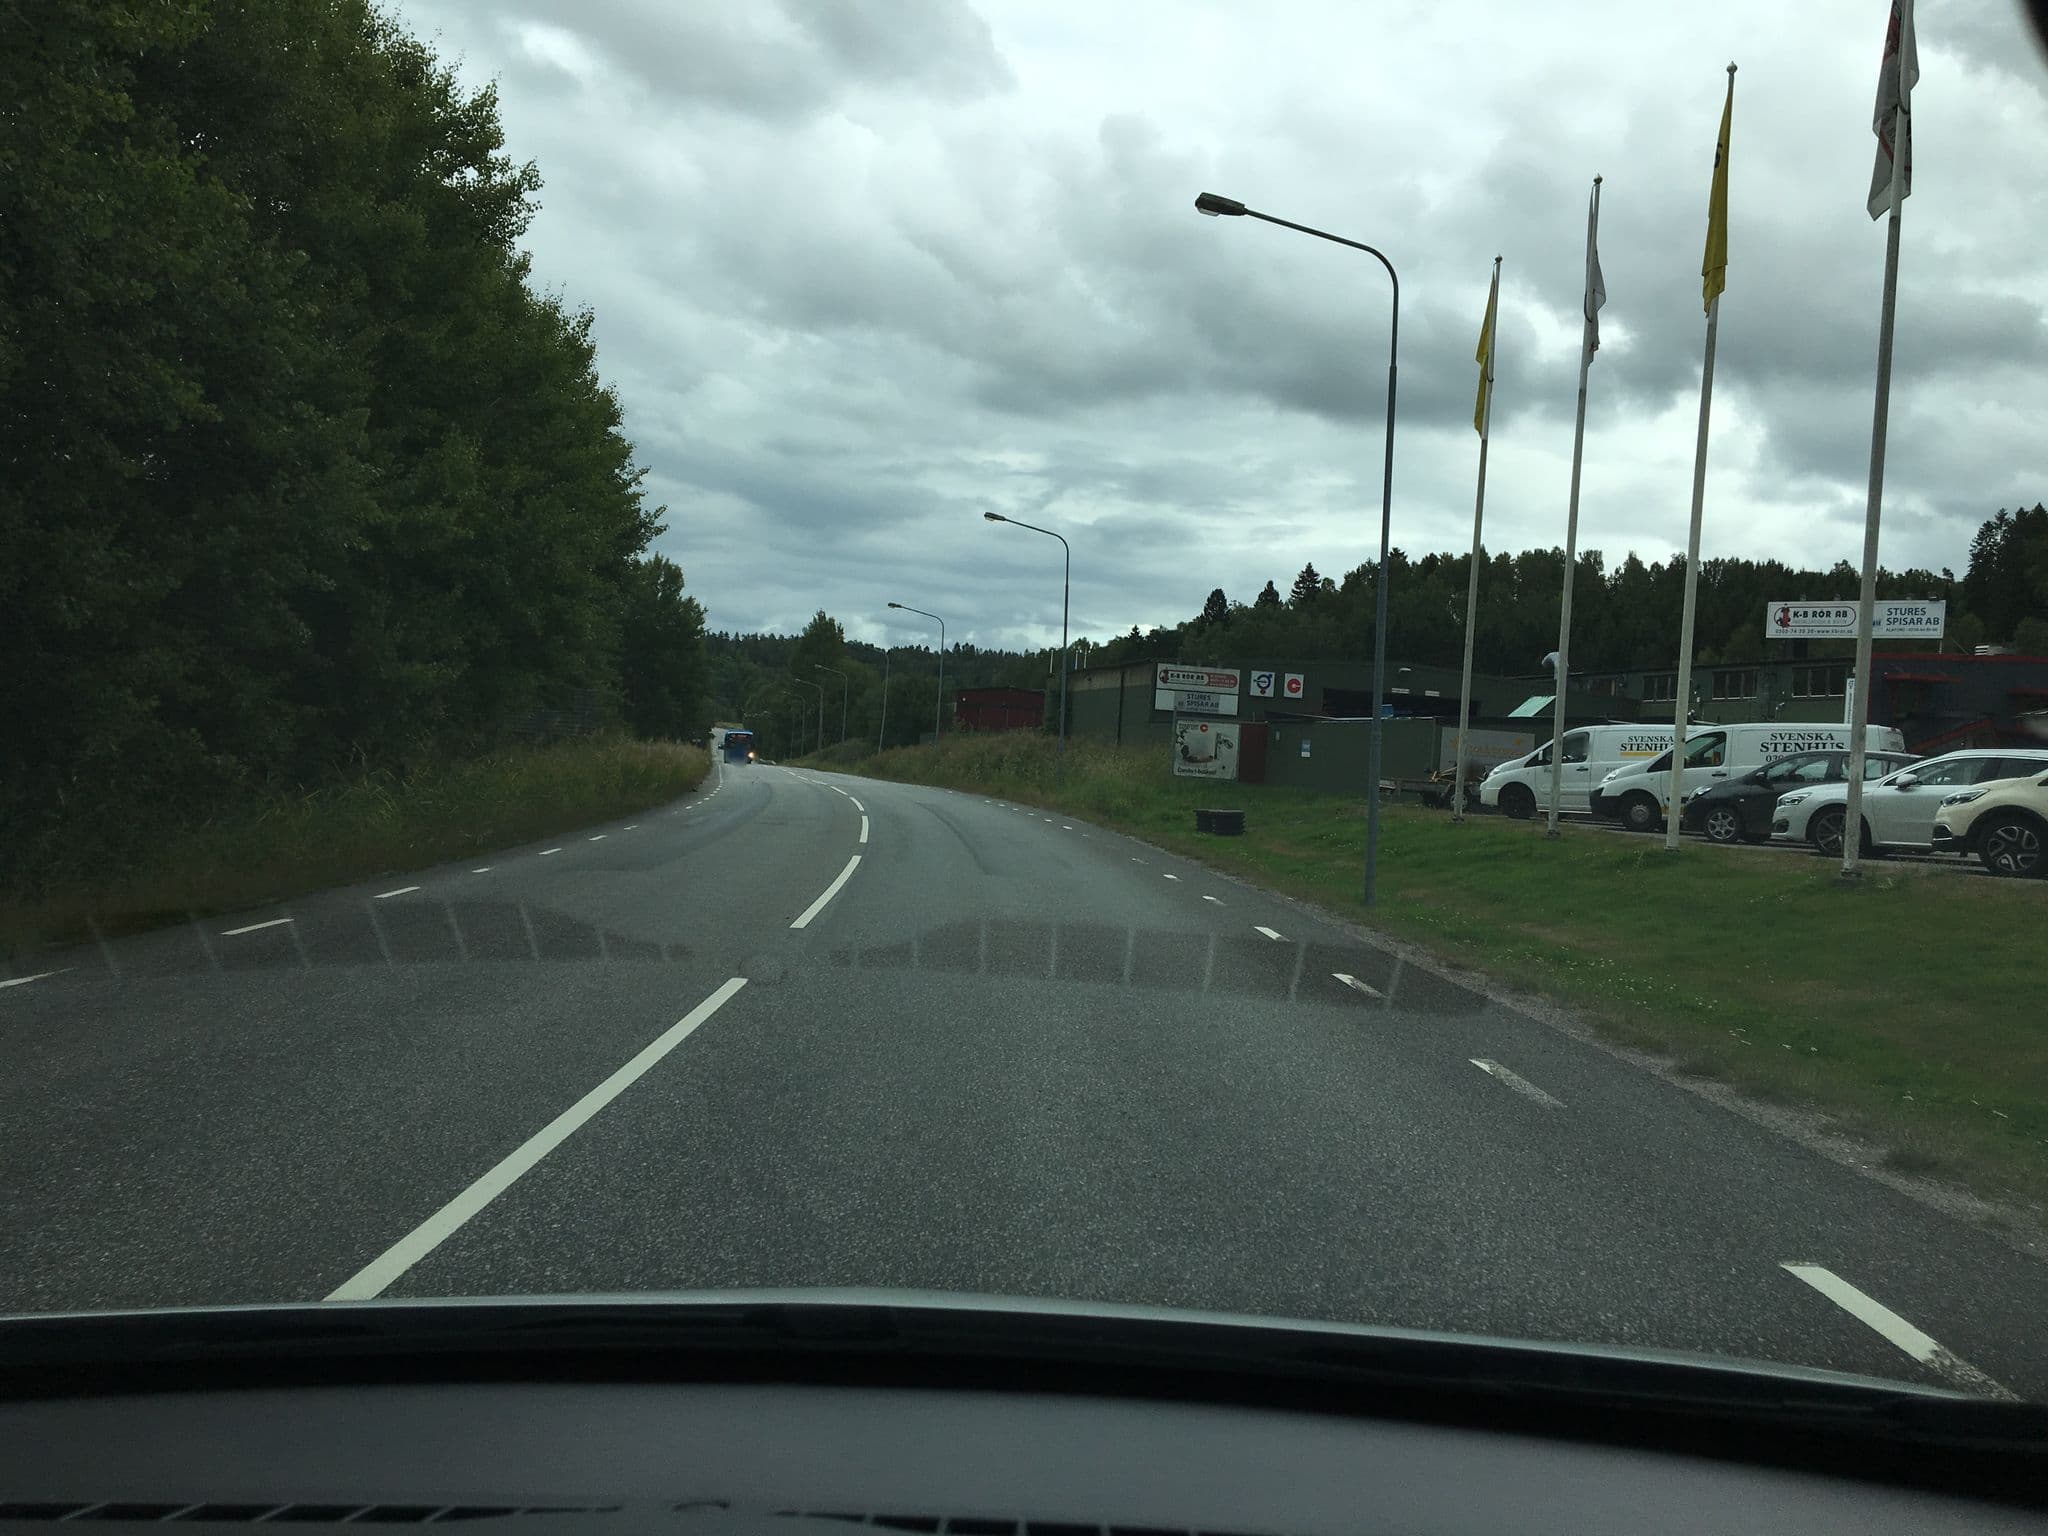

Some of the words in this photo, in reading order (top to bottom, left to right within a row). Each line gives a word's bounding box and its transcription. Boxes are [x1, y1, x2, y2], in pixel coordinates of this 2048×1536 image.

[1793, 610, 1809, 618] K-B
[1835, 610, 1848, 618] AB
[1887, 607, 1926, 616] STURES
[1886, 617, 1923, 626] SPISAR
[1925, 617, 1940, 626] AB
[1186, 693, 1212, 701] STURES
[1628, 735, 1674, 743] SVENSKA
[1770, 732, 1834, 741] SVENSKA
[1759, 742, 1845, 753] STENHUS
